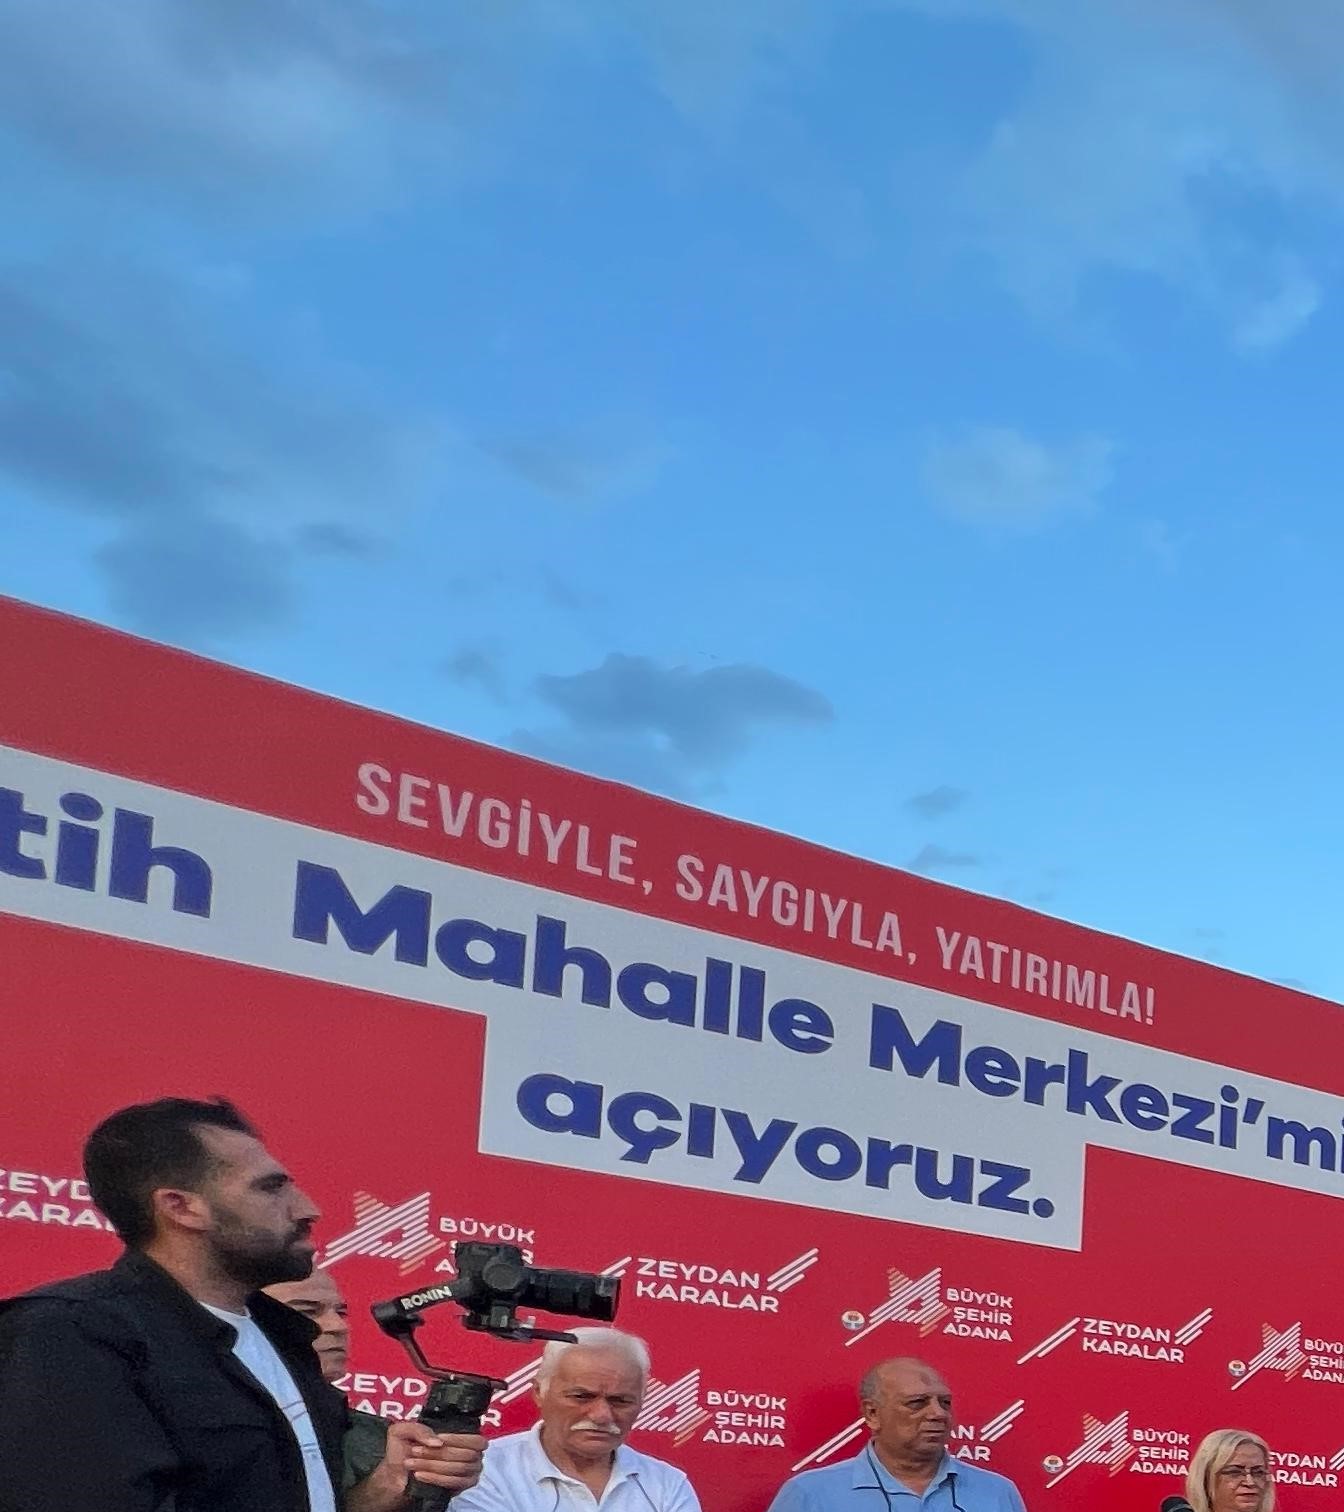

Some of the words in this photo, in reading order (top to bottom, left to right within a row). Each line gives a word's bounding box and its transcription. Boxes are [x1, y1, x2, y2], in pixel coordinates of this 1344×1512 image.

[356, 762, 654, 894] SEVGİYLE,
[675, 853, 918, 968] SAYGIYLA,
[935, 925, 1157, 1026] YATIRIMLA!
[293, 858, 834, 1054] Mahalle
[517, 1072, 1055, 1220] açıyoruz.
[438, 1216, 535, 1244] BÜYÜK
[635, 1257, 760, 1290] ZEYDAN
[400, 1285, 452, 1312] RONIN
[635, 1281, 780, 1313] KARALAR
[946, 1288, 1014, 1309] BÜYÜK
[953, 1305, 1013, 1326] ŞEHİR
[942, 1322, 1013, 1342] ADANA
[1082, 1317, 1171, 1344] ZEYDAN
[1082, 1337, 1185, 1364] KARALAR
[707, 1390, 786, 1411] BÜYÜK
[714, 1410, 786, 1430] ŞEHİR
[702, 1430, 785, 1447] ADANA
[1132, 1428, 1190, 1445] BÜYÜK
[1138, 1445, 1189, 1461] ŞEHİR
[1129, 1459, 1189, 1476] ADANA
